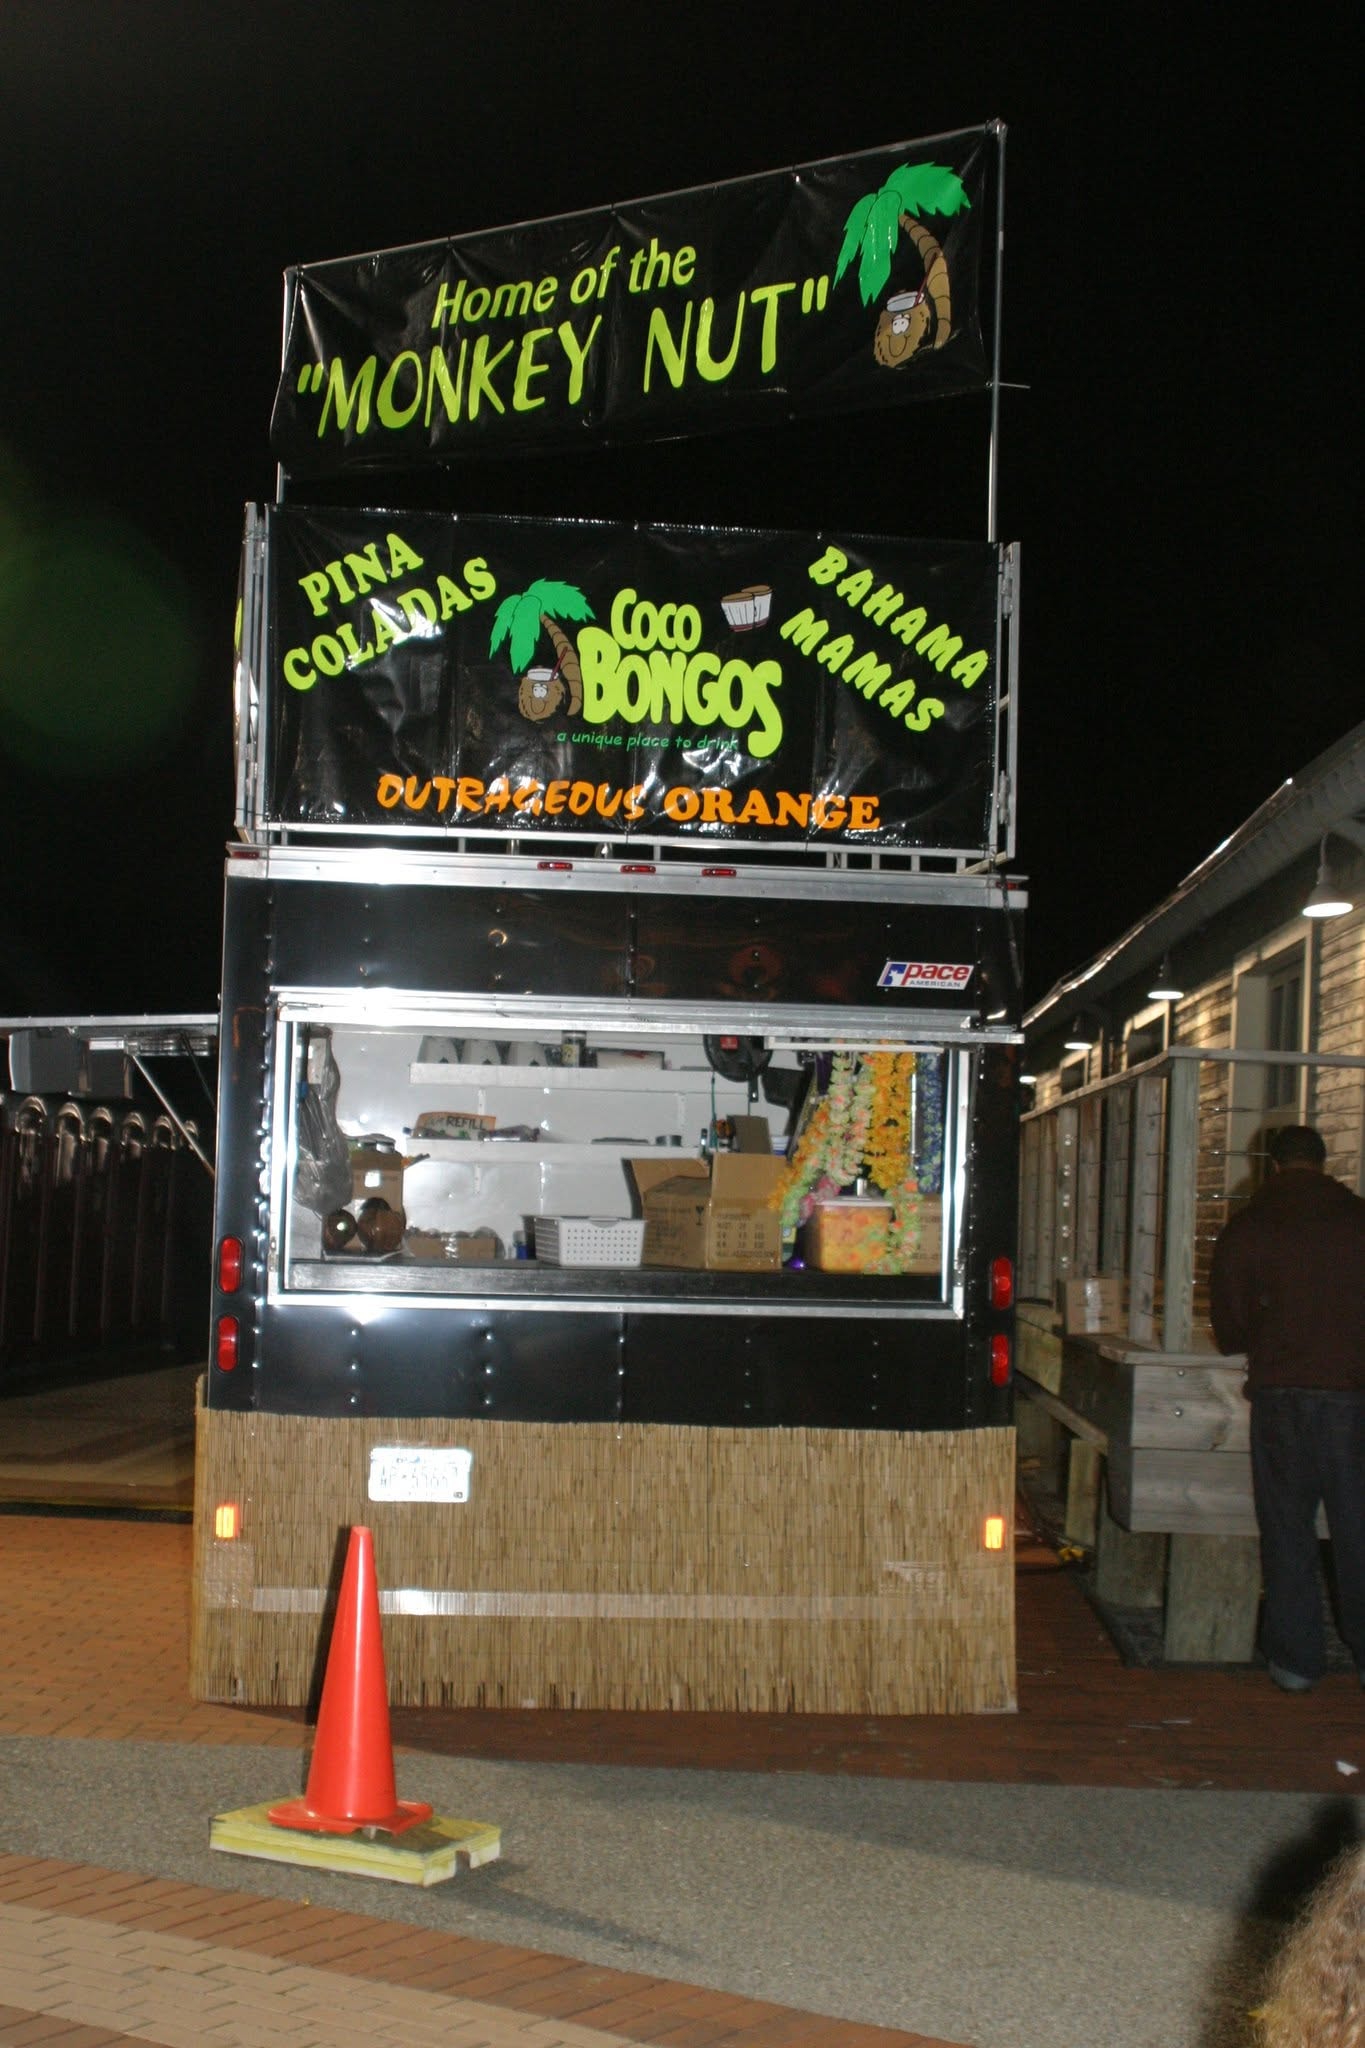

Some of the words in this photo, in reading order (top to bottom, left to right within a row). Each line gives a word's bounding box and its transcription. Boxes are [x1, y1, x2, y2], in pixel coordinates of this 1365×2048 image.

[431, 277, 558, 328] Home
[570, 246, 620, 299] of
[628, 238, 697, 294] the
[298, 314, 602, 437] "MONKEY
[644, 275, 829, 393] NUT"
[298, 533, 424, 616] PINA
[808, 546, 989, 688] BAHAMA
[284, 557, 496, 690] COLADAS
[577, 627, 783, 758] BONGOS
[780, 608, 945, 731] MAMAS
[557, 732, 567, 742] a
[572, 732, 622, 749] unique
[626, 734, 670, 752] place
[675, 735, 692, 748] to
[697, 735, 739, 751] drink
[376, 773, 646, 820] OUTRAGEOUS
[664, 786, 882, 831] ORANGE
[901, 963, 970, 985] pace
[447, 1116, 486, 1130] REFILL
